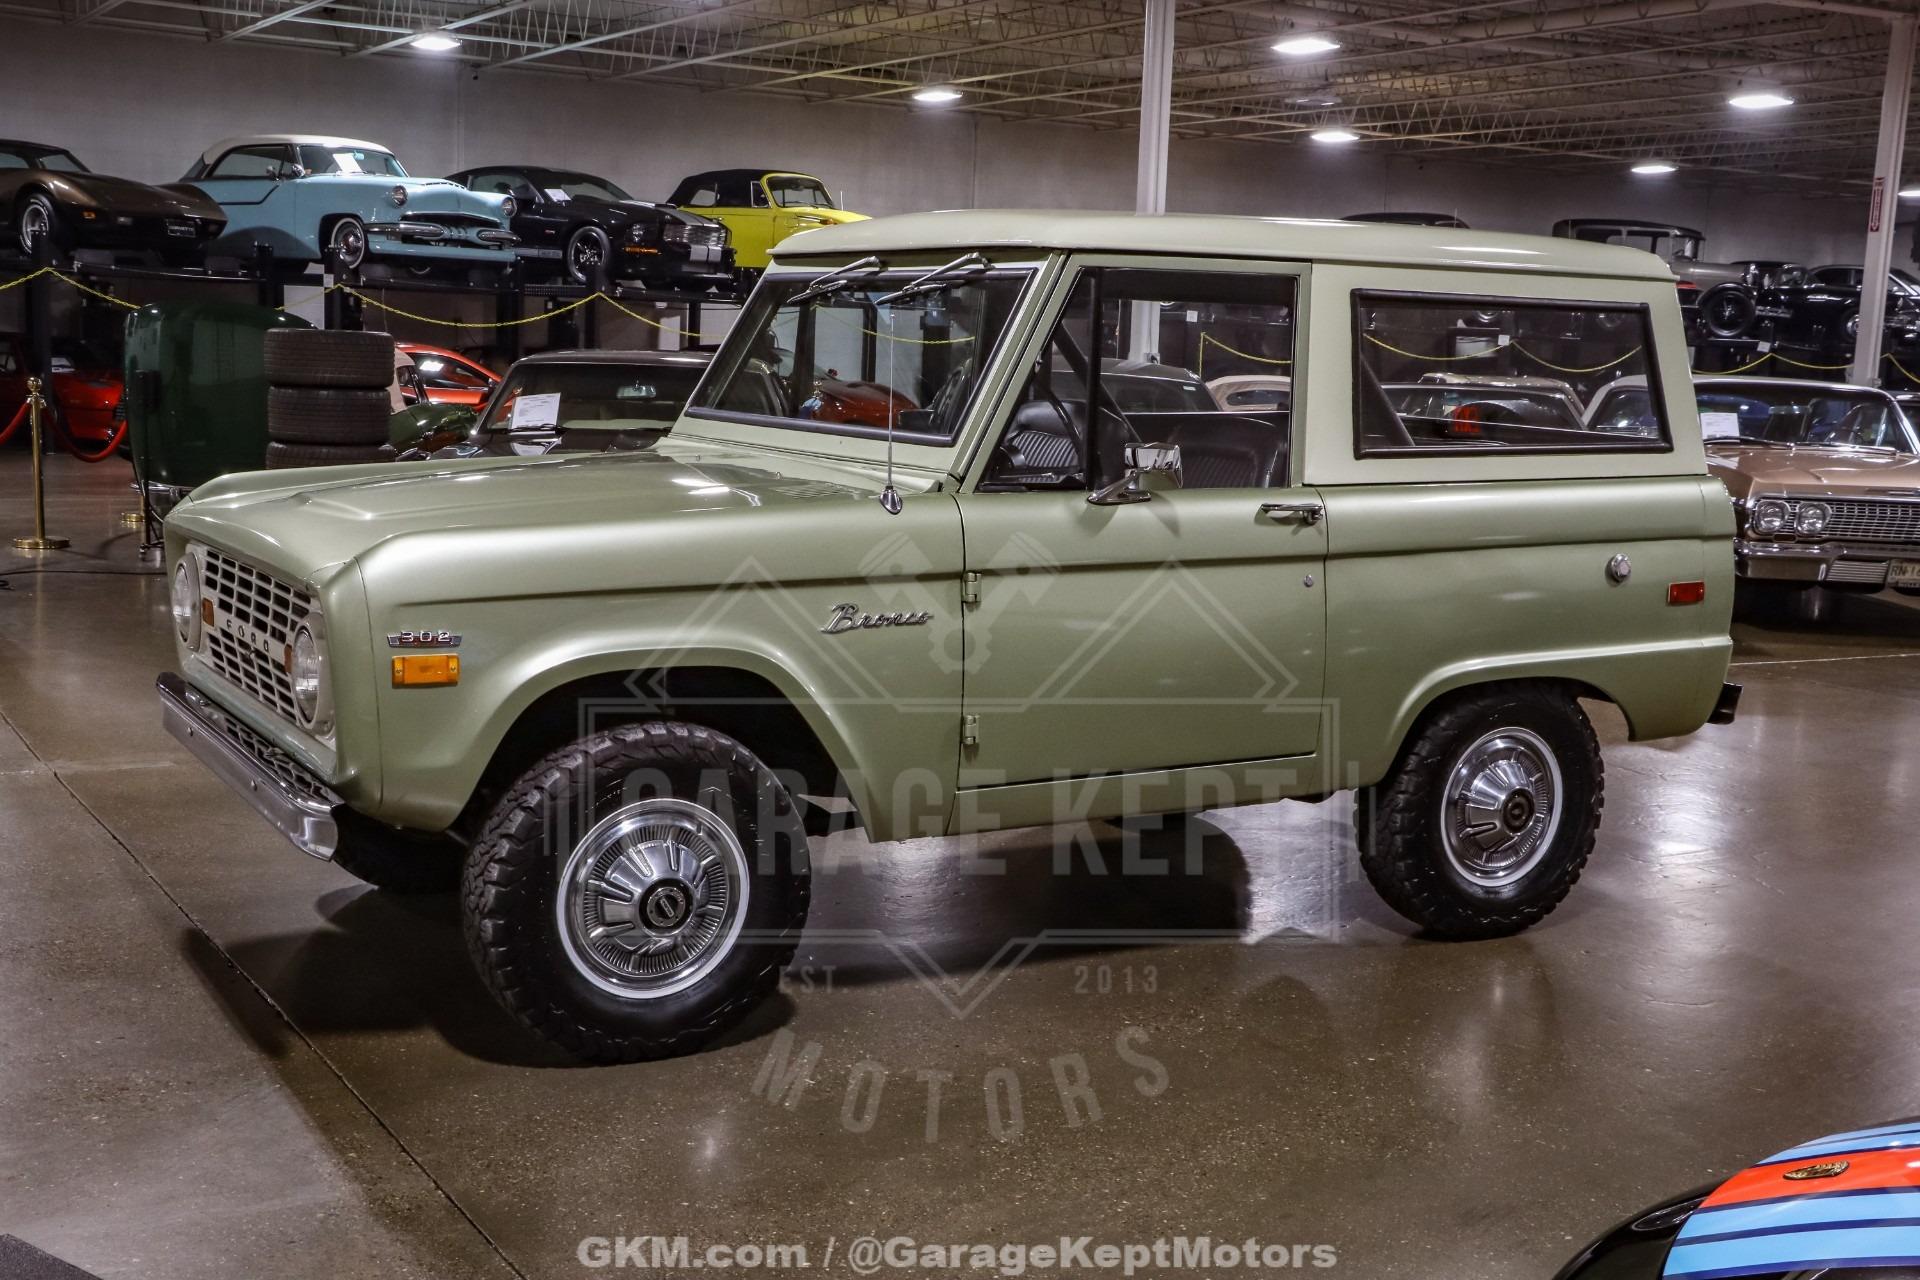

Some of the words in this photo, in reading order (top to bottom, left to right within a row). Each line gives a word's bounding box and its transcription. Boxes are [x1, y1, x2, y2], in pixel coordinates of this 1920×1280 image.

[819, 603, 934, 634] Bronco
[226, 618, 269, 653] FORD
[401, 630, 451, 642] 302
